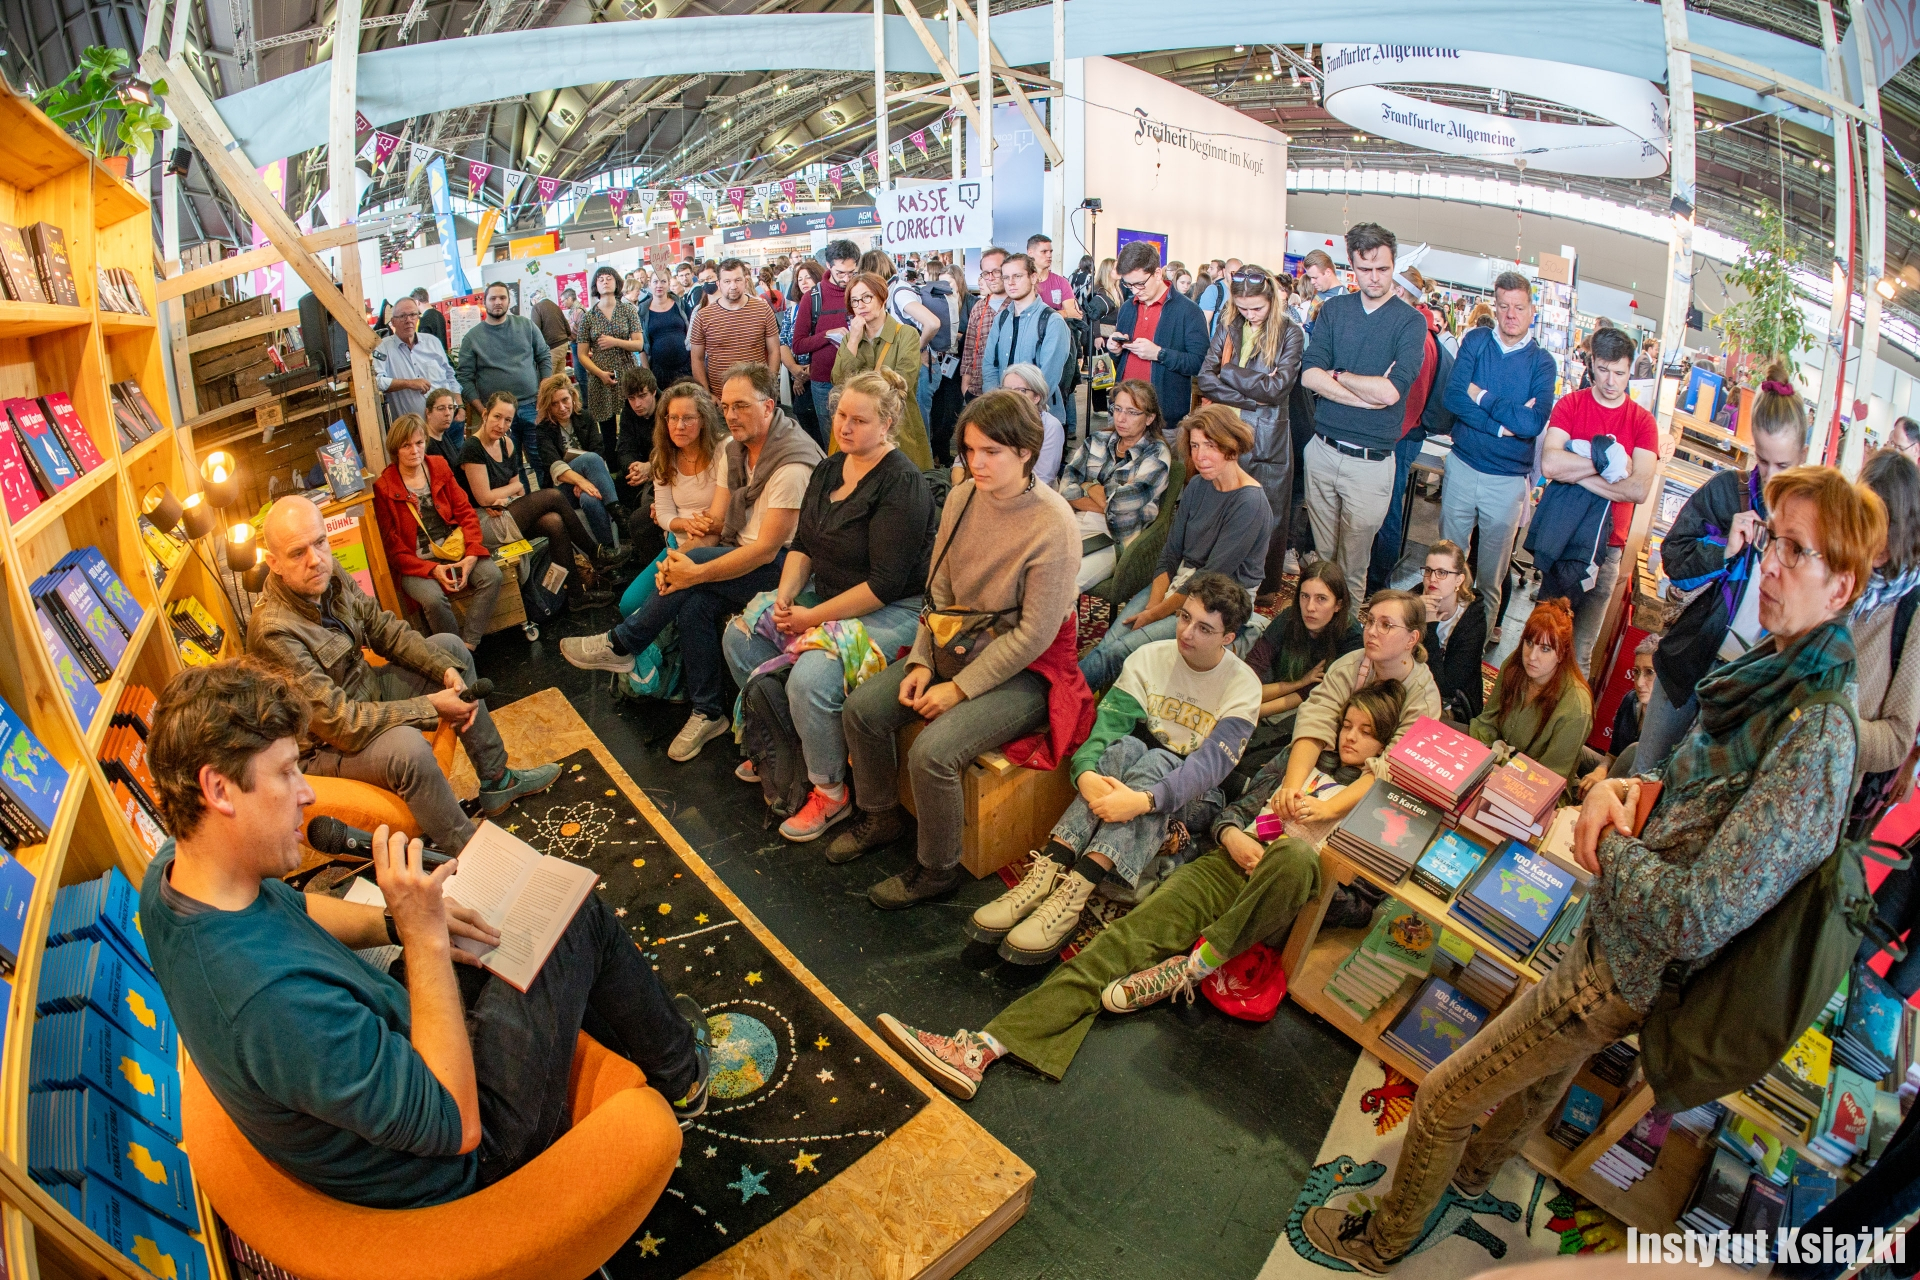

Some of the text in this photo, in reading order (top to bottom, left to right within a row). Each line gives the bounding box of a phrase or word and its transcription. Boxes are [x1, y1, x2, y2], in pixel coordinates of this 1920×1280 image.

[1381, 102, 1515, 148] Frankfurter Allgemeine
[1134, 107, 1264, 176] Freiheit beginnt im Kopf.
[769, 224, 779, 232] AGM
[859, 212, 871, 220] AGM
[887, 214, 965, 243] CORRECTIV
[1491, 259, 1527, 274] BOOKS
[326, 516, 354, 532] BÜHNE
[80, 650, 97, 672] KATAPULT
[89, 646, 105, 668] KATAPULT
[1403, 747, 1437, 770] Karten
[1435, 765, 1456, 782] 100
[1387, 791, 1429, 816] 55 Karten
[1502, 782, 1527, 801] KÖCHE
[1, 802, 27, 832] KATAPULT
[9, 801, 36, 830] KATAPULT
[1429, 858, 1456, 879] 365
[1512, 852, 1565, 889] 100 Karten
[1529, 872, 1551, 889] Gaming
[111, 981, 120, 1017] BEKNACKTE
[1434, 989, 1478, 1023] 100 Karten
[1843, 1092, 1858, 1119] WIR
[1845, 1124, 1865, 1135] NICHT
[110, 1106, 123, 1181] BEKNACKTE HEIMAT
[111, 1196, 122, 1226] HEIMAT
